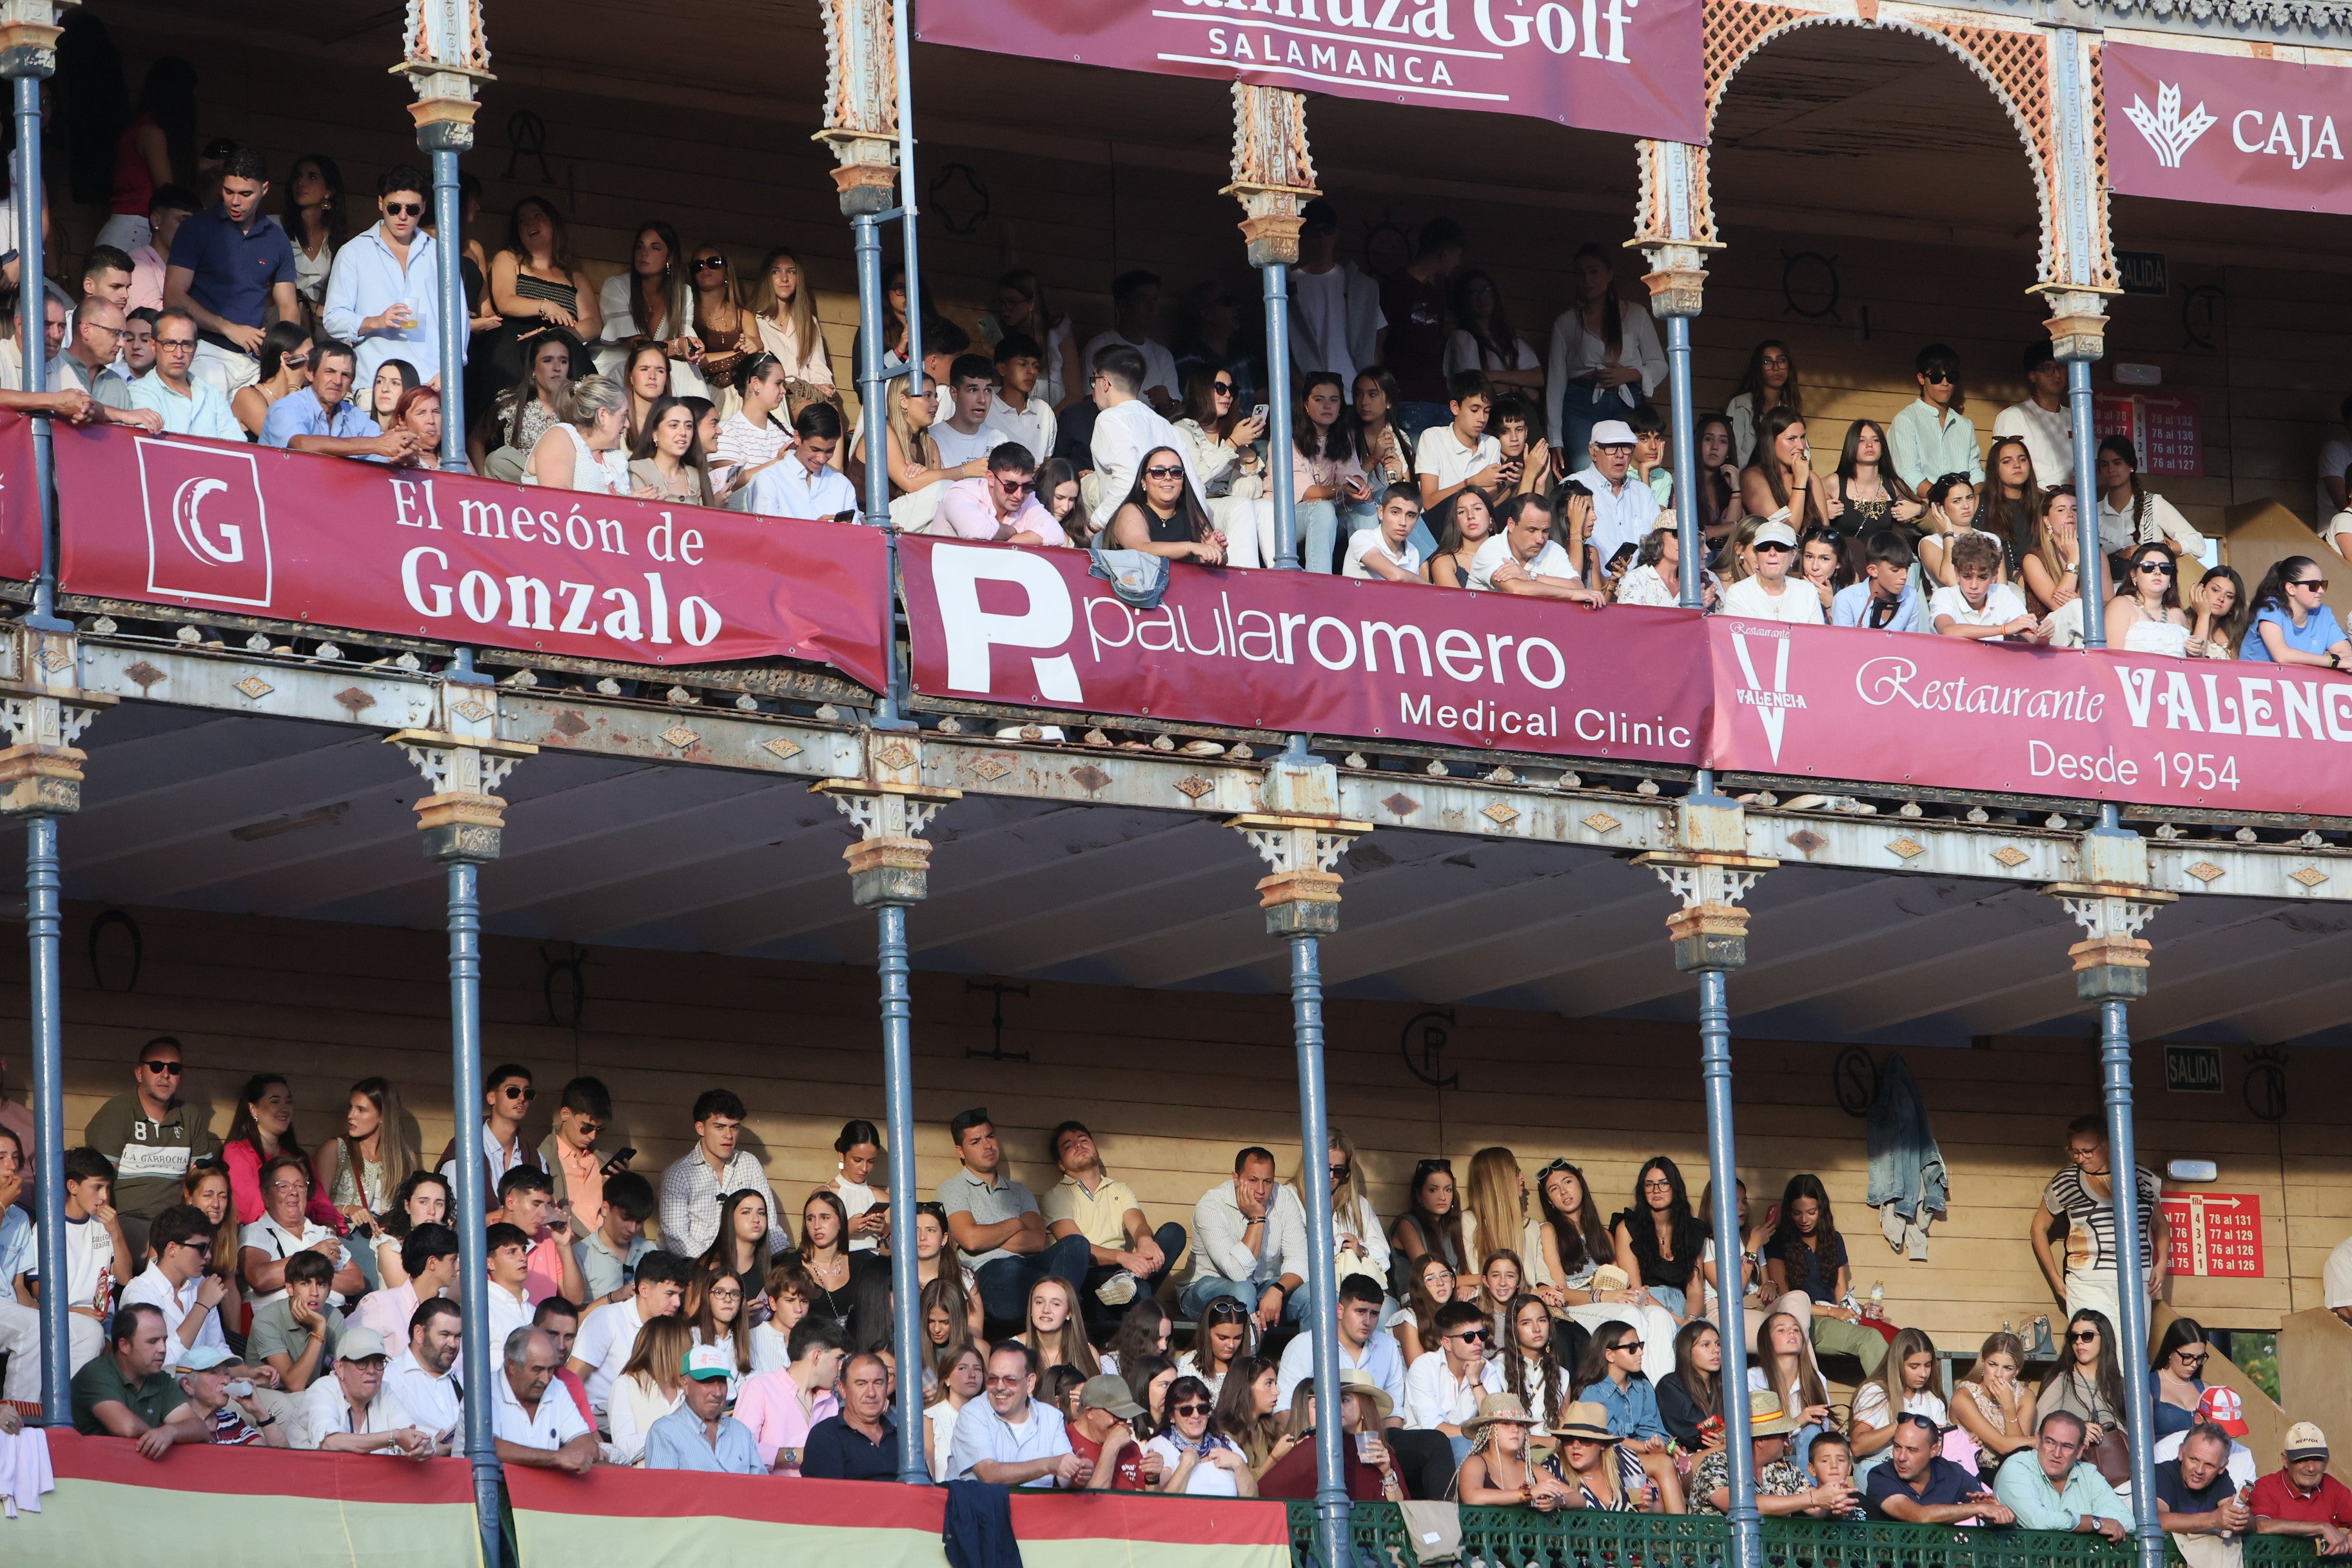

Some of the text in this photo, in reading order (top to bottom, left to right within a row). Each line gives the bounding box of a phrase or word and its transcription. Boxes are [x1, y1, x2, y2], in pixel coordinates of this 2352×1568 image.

[1473, 0, 1639, 64] Golf
[1208, 28, 1453, 86] SALAMANCA
[2233, 110, 2344, 170] CAJA
[2104, 411, 2112, 419] al
[2116, 411, 2126, 420] 78
[2165, 415, 2173, 424] al
[2177, 415, 2193, 426] 132
[2105, 426, 2113, 435] al
[2116, 426, 2127, 435] 77
[2137, 427, 2142, 436] 3
[2151, 429, 2162, 438] 78
[2166, 430, 2174, 439] al
[2177, 430, 2193, 440] 130
[2138, 442, 2142, 452] 2
[2152, 443, 2163, 453] 76
[2166, 444, 2175, 454] al
[2178, 445, 2194, 455] 127
[2139, 457, 2195, 470] 1 76 al 127
[389, 478, 703, 565] El mesón de
[401, 546, 722, 647] Gonzalo
[1729, 622, 1790, 639] Restaurante
[1083, 591, 1566, 689] paularomero
[1856, 656, 2105, 723] Restaurante
[1736, 688, 1808, 709] VALENCIA
[1400, 692, 1691, 748] Medical Clinic
[2028, 740, 2241, 791] Desde 1954
[2168, 1055, 2219, 1084] SALIDA
[134, 1121, 147, 1141] 8
[124, 1152, 187, 1164] LA GARROCHA
[2192, 1197, 2202, 1206] fila
[2174, 1213, 2186, 1223] 77
[2195, 1213, 2200, 1224] 4
[2209, 1214, 2221, 1224] 78
[2223, 1215, 2232, 1225] al
[2235, 1215, 2251, 1226] 131
[92, 1234, 111, 1243] COLLEGE
[2175, 1228, 2187, 1239] 76
[2196, 1228, 2201, 1239] 3
[2210, 1229, 2222, 1239] 77
[2224, 1230, 2233, 1240] al
[2236, 1230, 2253, 1240] 129
[93, 1240, 110, 1250] LEAGUE
[2176, 1242, 2188, 1253] 75
[2197, 1244, 2202, 1254] 2
[2210, 1244, 2223, 1255] 76
[2225, 1244, 2234, 1255] al
[2237, 1245, 2254, 1256] 126
[2166, 1257, 2255, 1271] al 75 1 76 al 126
